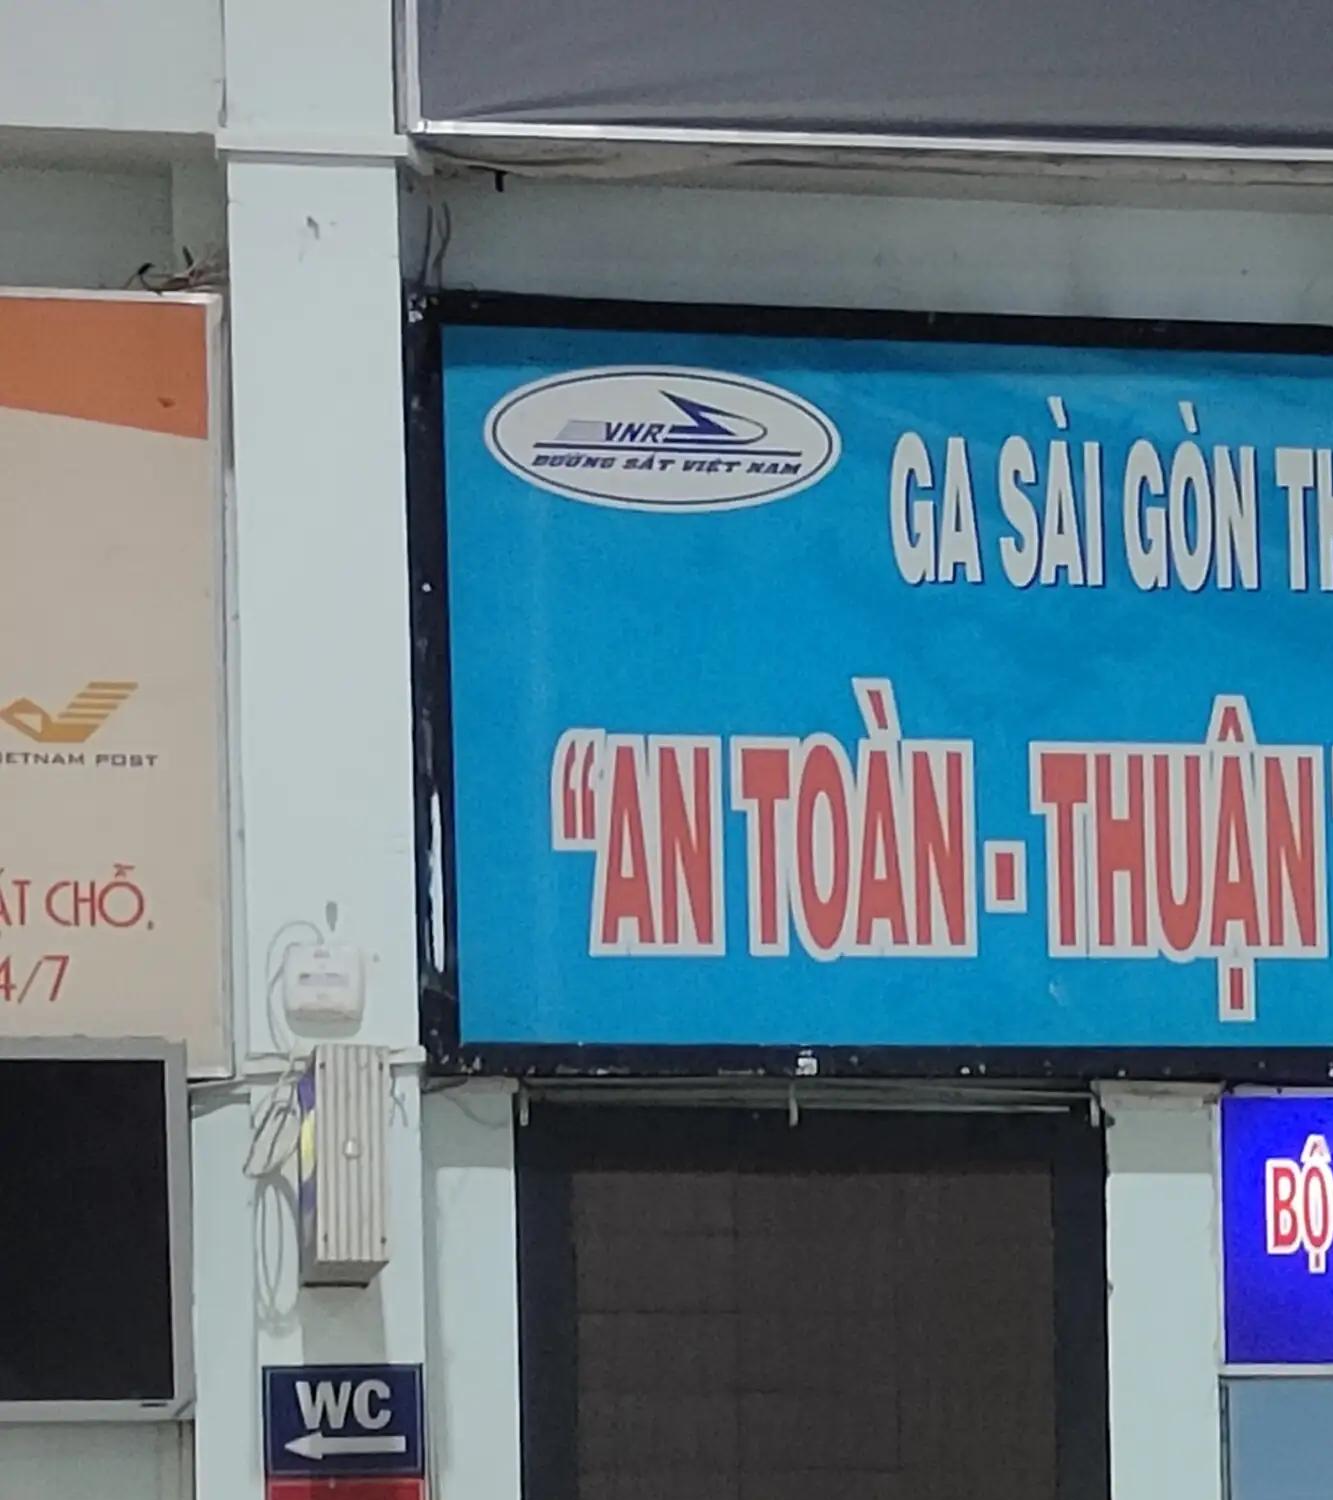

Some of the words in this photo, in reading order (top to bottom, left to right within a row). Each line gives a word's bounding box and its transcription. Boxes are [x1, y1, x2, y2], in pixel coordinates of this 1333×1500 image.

[604, 421, 666, 443] VNR
[746, 461, 802, 475] NAM
[890, 431, 984, 586] GA
[1000, 395, 1105, 589] SÀI
[1123, 401, 1259, 592] GÒN
[96, 754, 159, 768] POST
[730, 677, 978, 962] TOÀN
[1029, 694, 1329, 1022] THUẬN
[0, 954, 70, 1004] 4/7
[295, 1379, 392, 1430] WC
